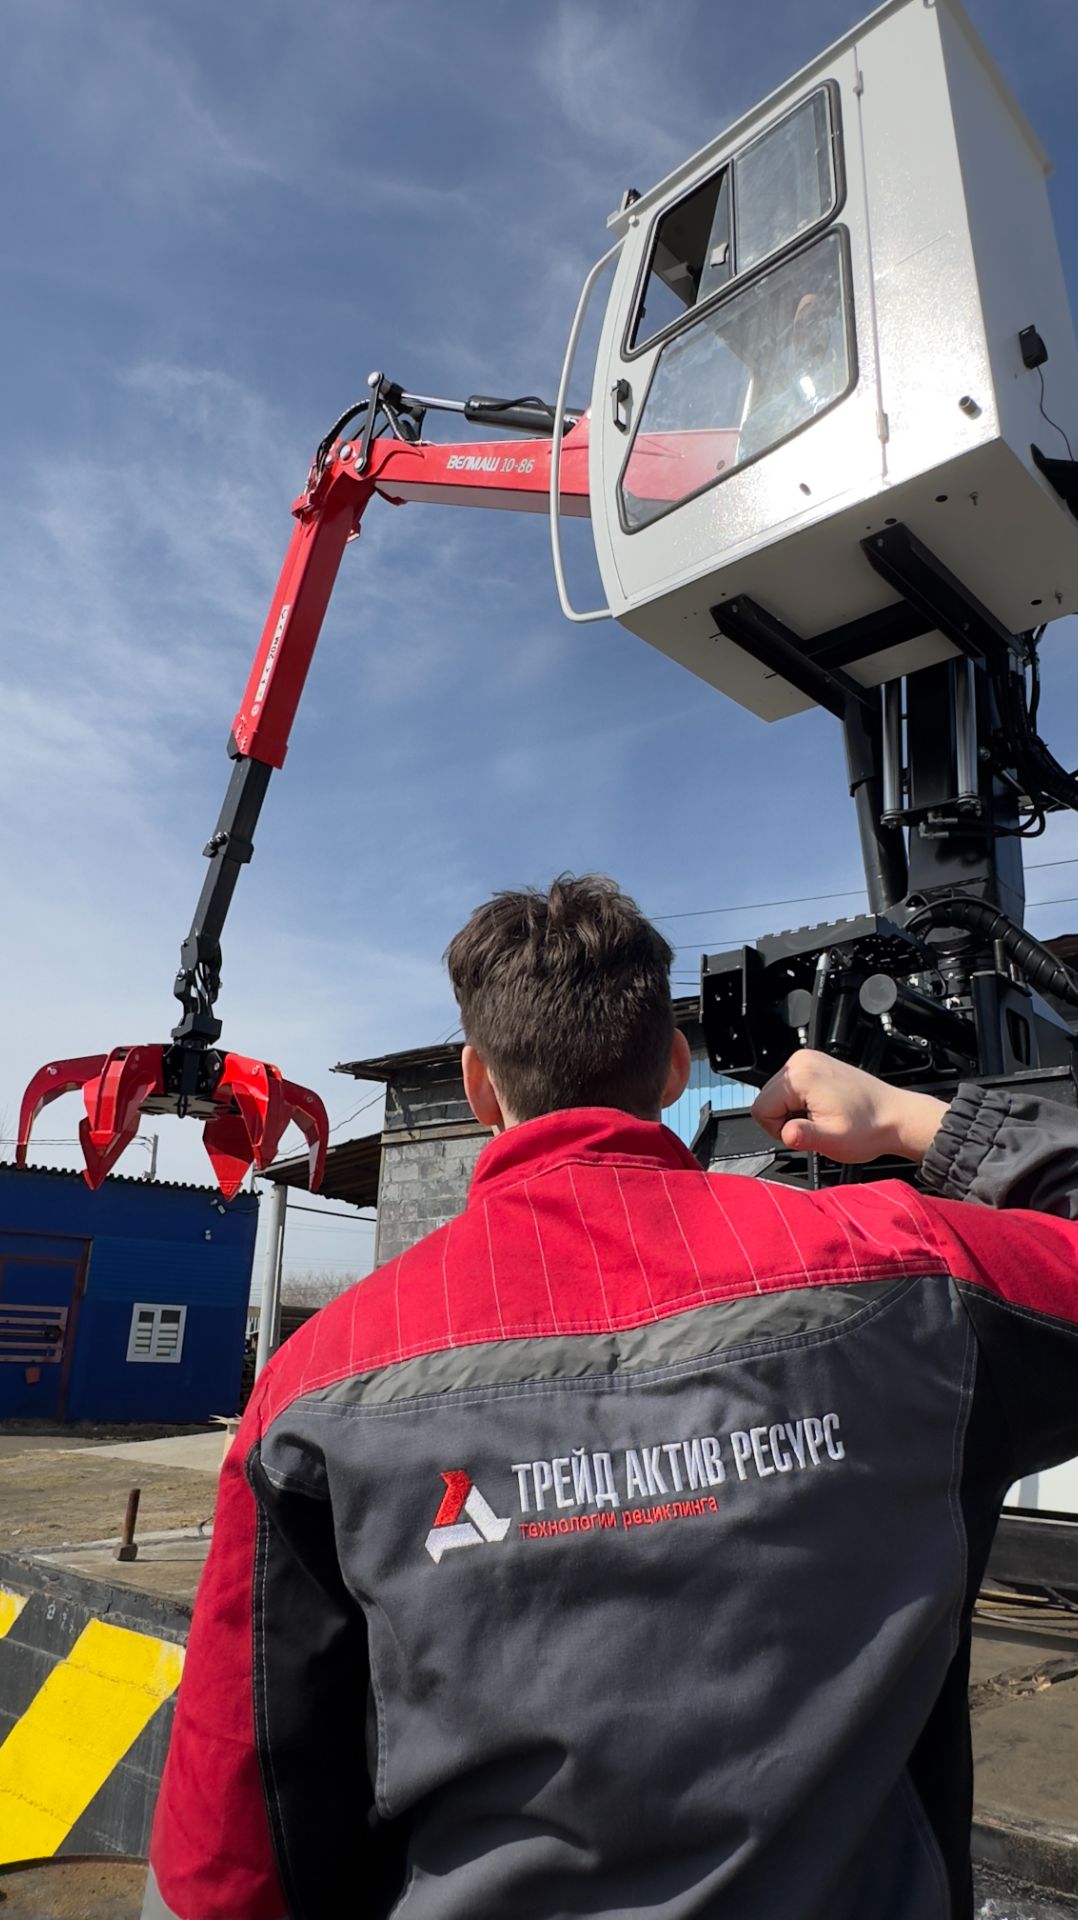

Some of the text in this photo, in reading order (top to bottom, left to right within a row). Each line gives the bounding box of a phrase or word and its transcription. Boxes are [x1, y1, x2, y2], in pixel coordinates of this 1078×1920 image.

[446, 455, 535, 473] ВЕЛМАШ 10-86
[511, 1412, 846, 1512] ТРЕЙД АКТИВ РЕСУРС
[518, 1495, 719, 1540] технологии рециклинга
